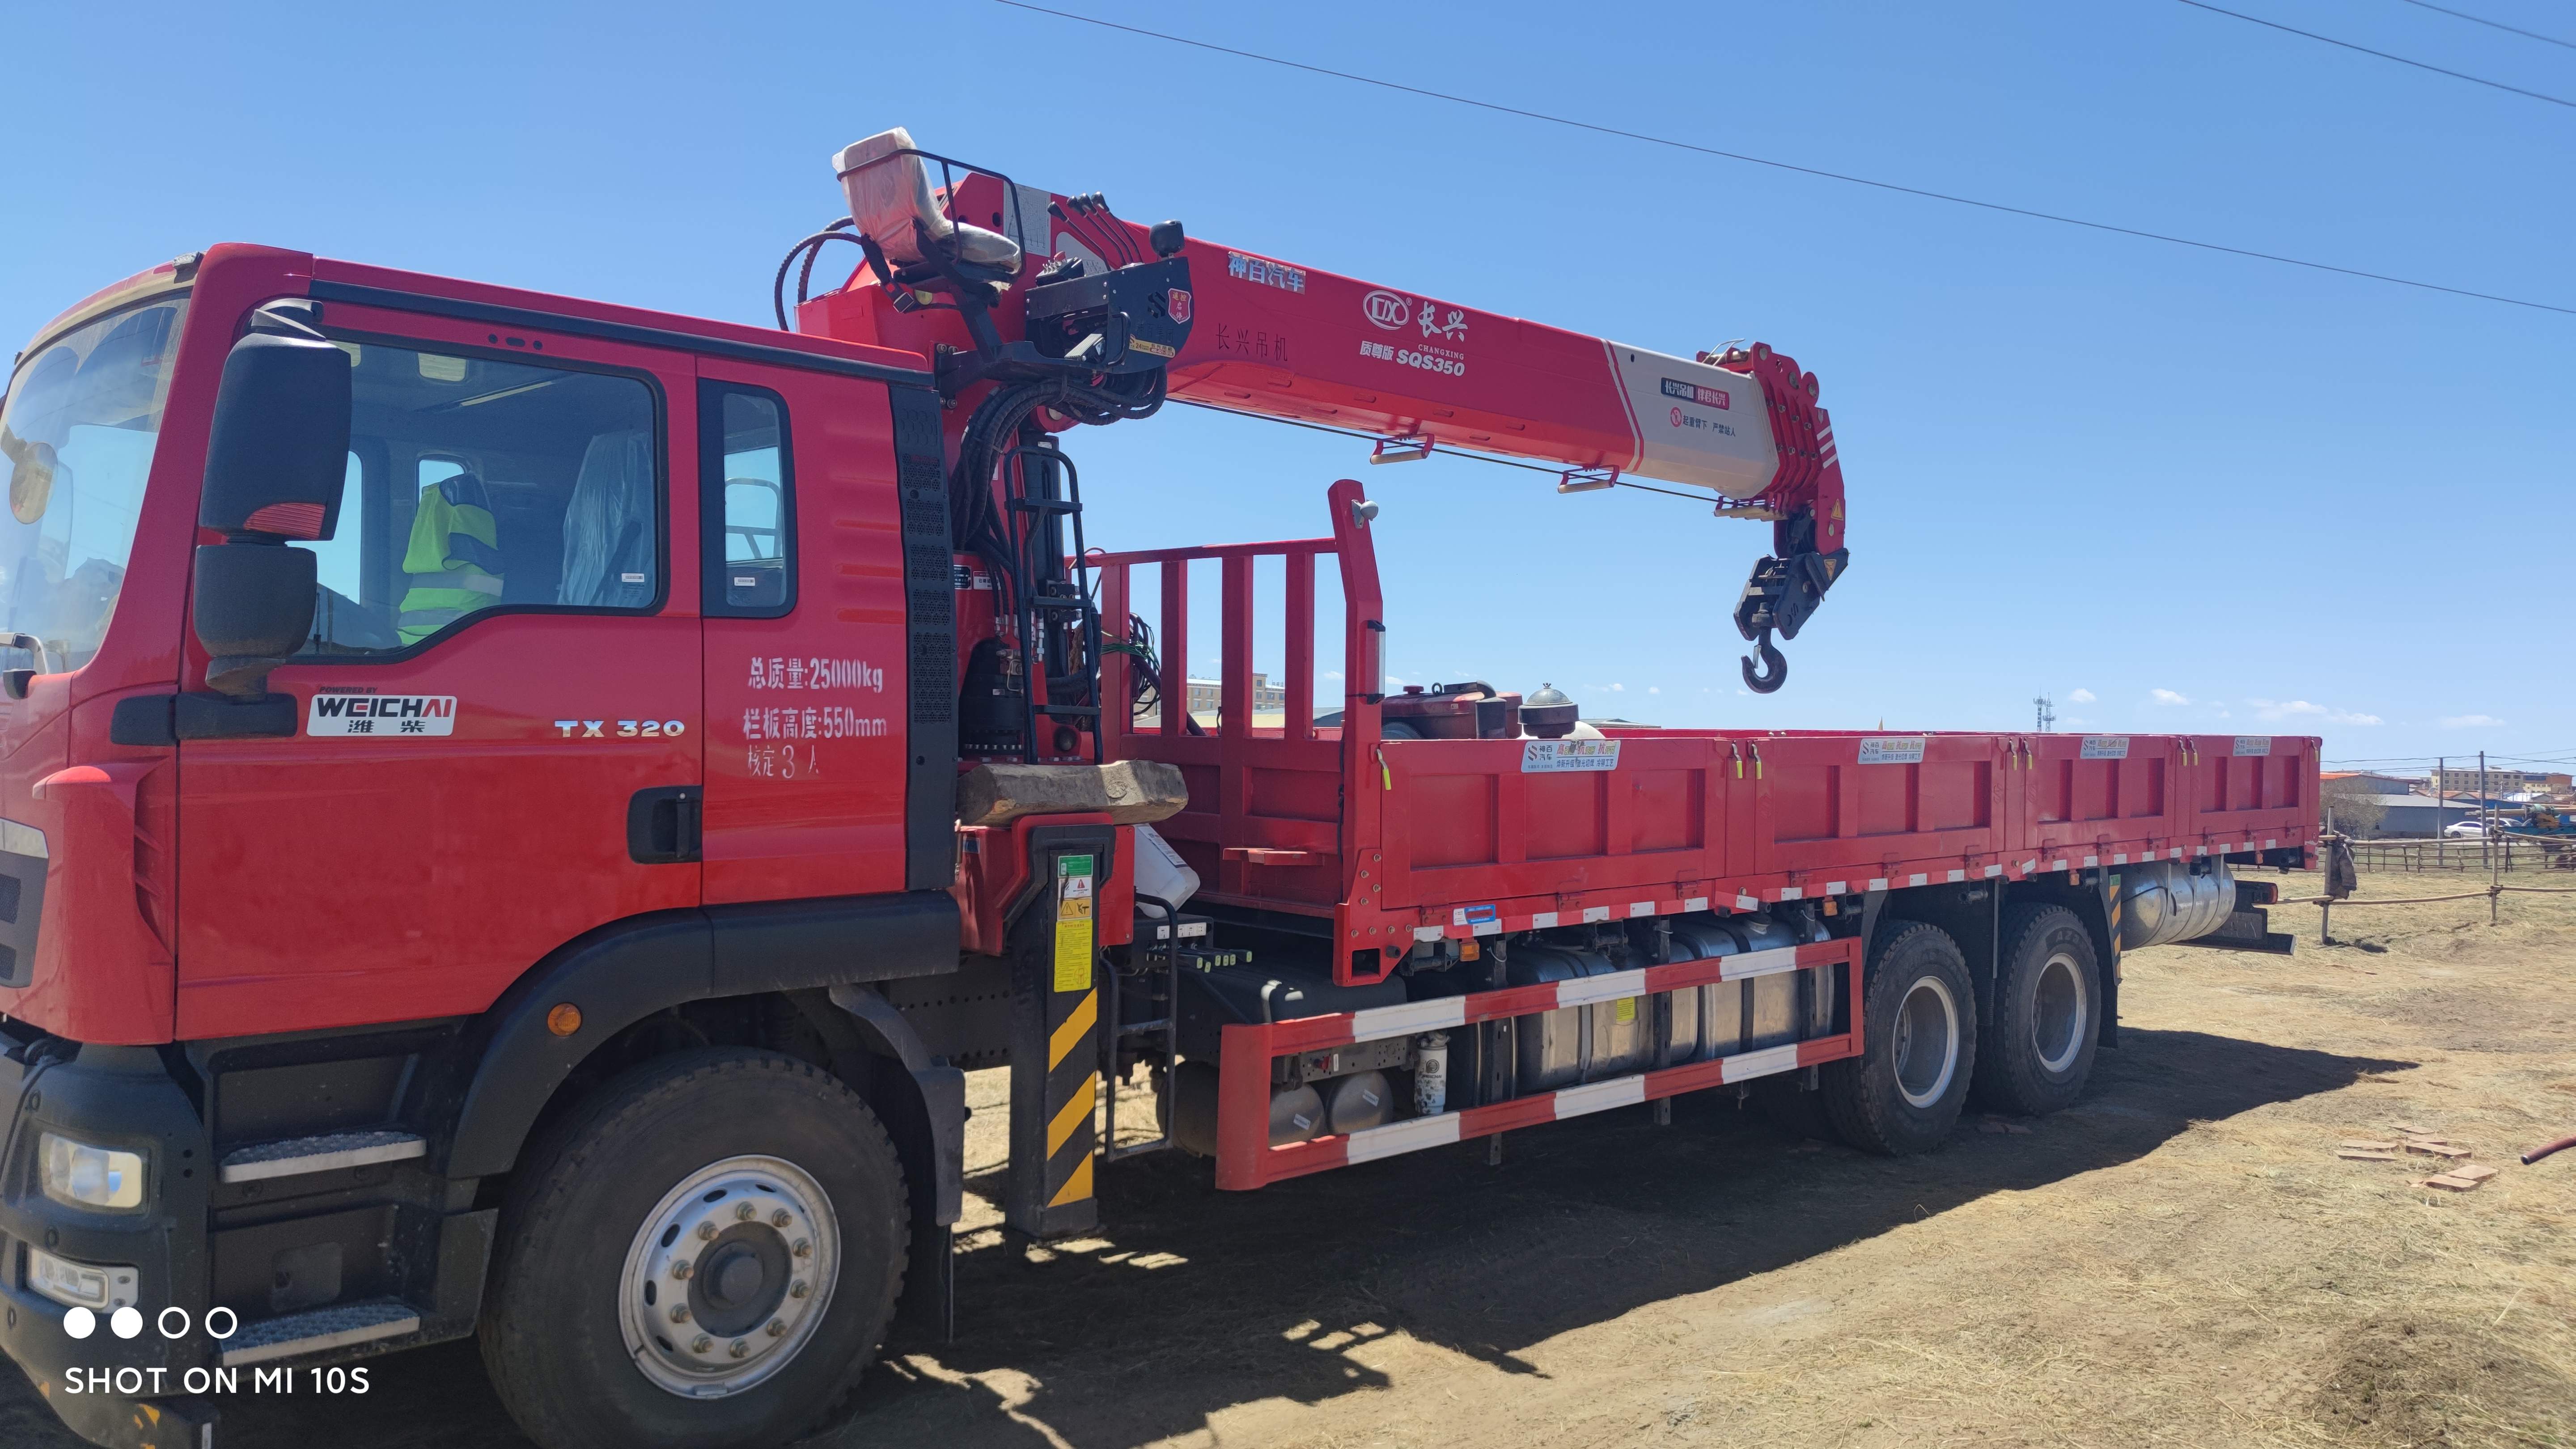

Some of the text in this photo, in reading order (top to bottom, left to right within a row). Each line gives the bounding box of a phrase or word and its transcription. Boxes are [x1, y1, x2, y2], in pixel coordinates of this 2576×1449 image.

[1228, 254, 1304, 292] 神百汽车
[1417, 300, 1468, 342] 长兴
[1216, 322, 1288, 361] 长兴吊机
[1360, 340, 1465, 377] 质尊版 SQS350
[1418, 343, 1464, 360] CHANGXING
[1665, 380, 1694, 399] 长兴吊机
[1682, 415, 1736, 437] 起重臂下 严禁站人
[748, 657, 883, 693] 总质量:25000kg
[317, 697, 453, 717] WEICHAI
[743, 706, 887, 740] 栏板高度:550mm
[347, 720, 426, 733] 潍柴
[555, 720, 685, 737] TX 320
[747, 744, 819, 779] 核定 3 人
